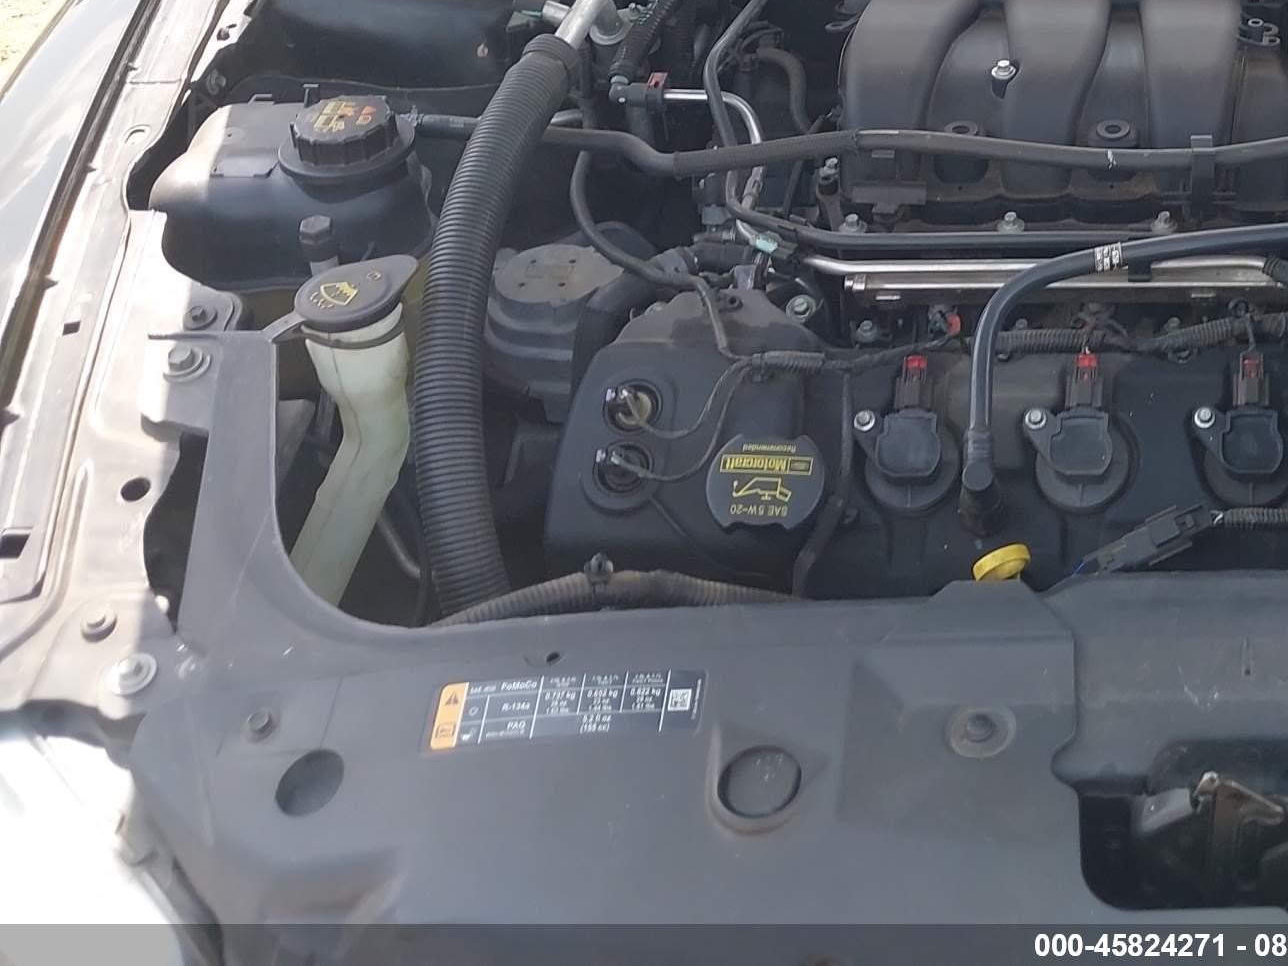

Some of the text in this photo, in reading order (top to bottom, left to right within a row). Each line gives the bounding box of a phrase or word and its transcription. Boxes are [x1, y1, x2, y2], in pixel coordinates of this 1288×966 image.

[742, 443, 797, 453] Recommended
[726, 457, 788, 471] Motorcraft
[730, 504, 788, 516] SAE 5W-20
